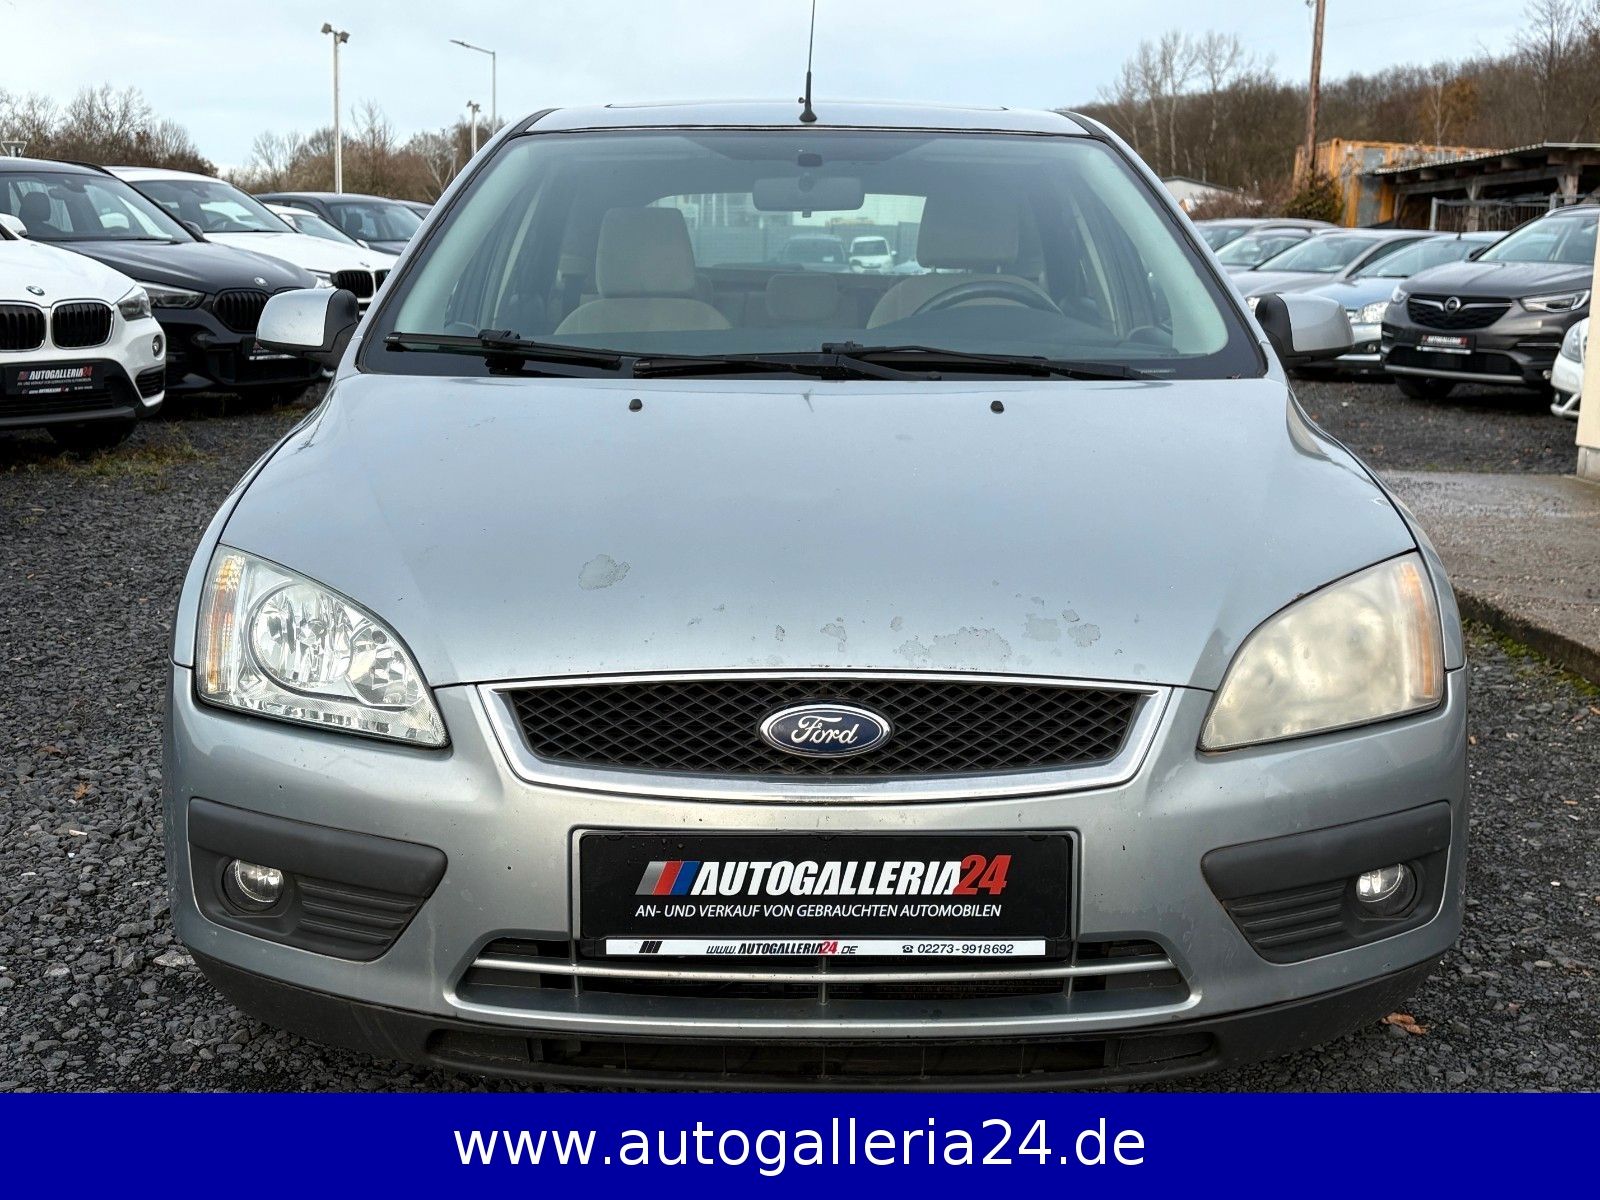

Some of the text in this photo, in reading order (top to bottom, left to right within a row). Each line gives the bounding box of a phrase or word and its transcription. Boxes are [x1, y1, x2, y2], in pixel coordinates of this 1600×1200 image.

[29, 367, 93, 380] AUTOGALLERIA24
[791, 715, 859, 744] Ford
[690, 855, 1012, 896] AUTOGALLERIA24
[635, 904, 1002, 918] AN- UND VERKAUF VON GEBRAUCHTEN AUTOMOBILEN
